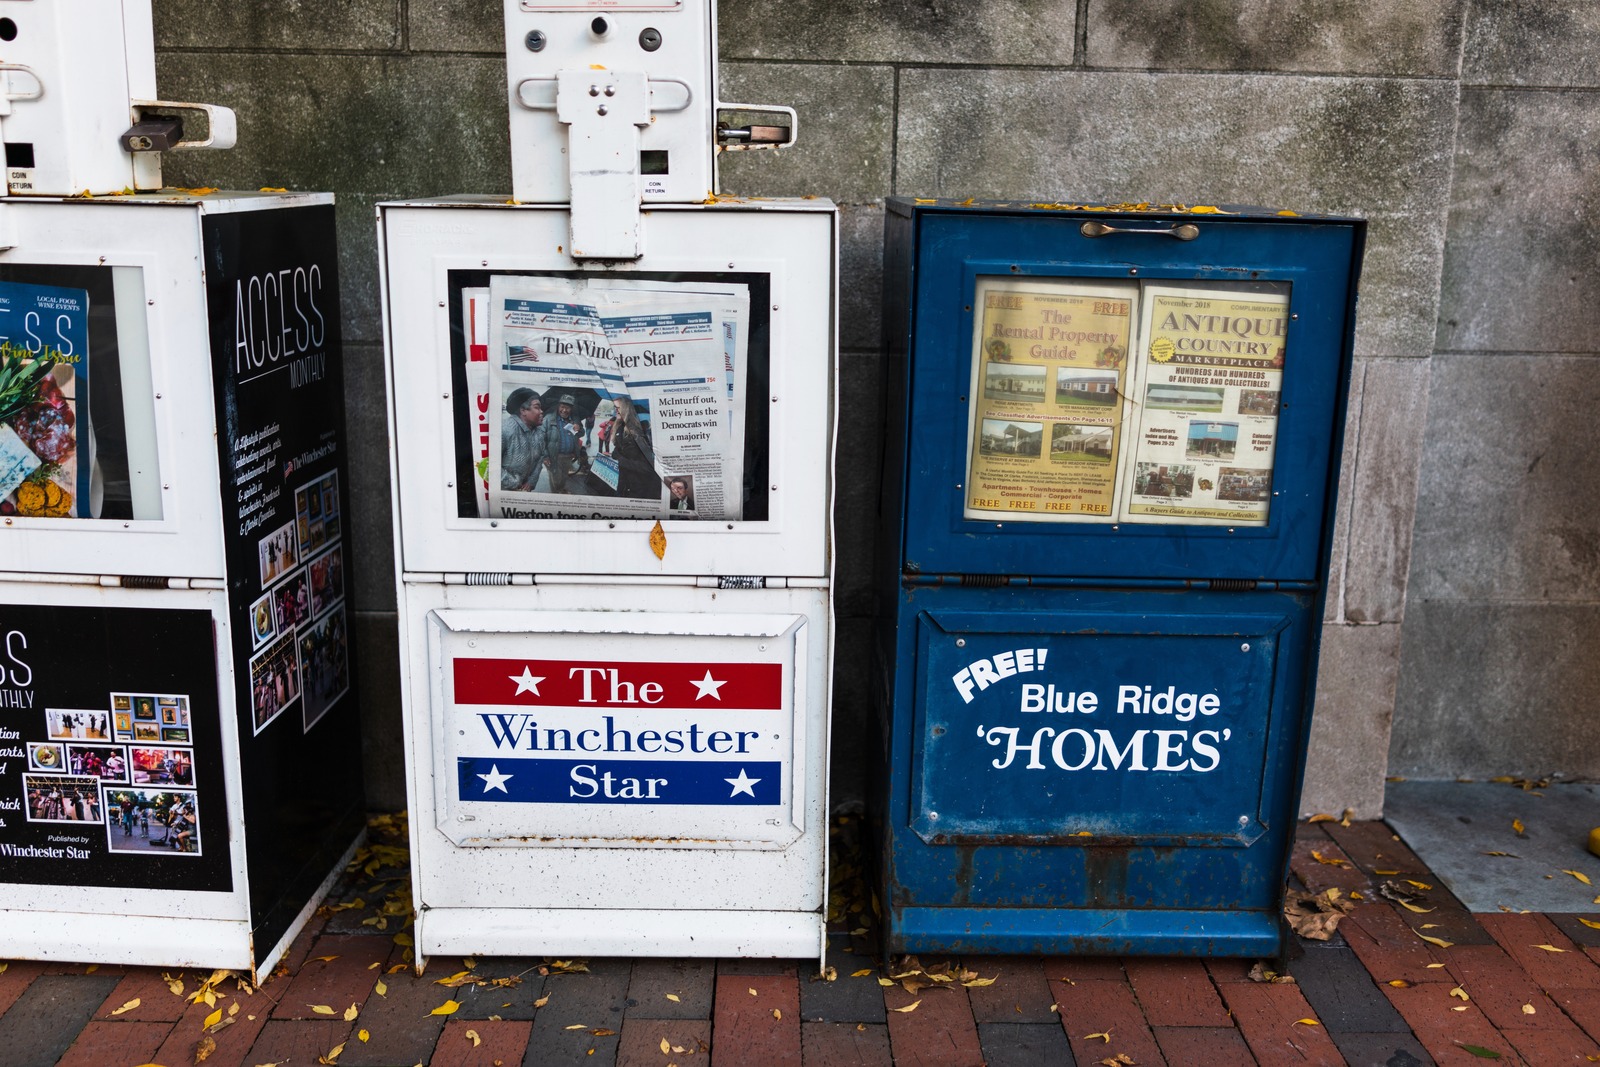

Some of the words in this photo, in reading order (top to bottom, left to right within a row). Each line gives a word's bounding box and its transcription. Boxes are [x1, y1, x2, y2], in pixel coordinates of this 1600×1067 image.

[36, 296, 57, 304] LOCAL
[987, 295, 1024, 310] FREE
[1158, 298, 1193, 308] November
[56, 304, 80, 312] EVENTS
[1092, 302, 1128, 316] FREE
[1231, 304, 1280, 313] COMPLIMENTARY
[236, 264, 324, 374] ACCESS
[1041, 310, 1072, 324] The
[992, 323, 1044, 340] Rental
[1048, 328, 1118, 347] Property
[41, 344, 82, 364] Issue
[542, 336, 574, 355] The
[644, 350, 674, 367] Star
[1030, 344, 1076, 360] Guide
[1176, 337, 1272, 356] COUNTRY
[1175, 355, 1270, 368] MARKETPLACE
[290, 352, 326, 389] MONTHLY
[1175, 367, 1212, 376] HUNDREDS
[1229, 370, 1265, 379] HUNDREDS
[1178, 376, 1209, 384] ANTIQUES
[1224, 378, 1270, 388] COLLECTIBLES!
[659, 396, 699, 406] McInturff
[659, 409, 682, 418] Wiley
[662, 420, 702, 430] Democrats
[676, 432, 710, 442] majority
[972, 498, 1000, 507] FREE
[1009, 500, 1036, 509] FREE
[1045, 502, 1072, 510] FREE
[1080, 503, 1108, 512] FREE
[952, 648, 1048, 704] FREE!
[569, 668, 664, 703] The
[0, 689, 34, 709] THLY
[1020, 684, 1098, 714] Blue
[1116, 685, 1220, 722] Ridge
[476, 714, 760, 754] Winchester
[976, 724, 1232, 772] 'HOMES'
[569, 764, 668, 799] Star
[48, 835, 80, 843] Published
[0, 844, 64, 858] Winchester
[66, 846, 90, 859] Star
